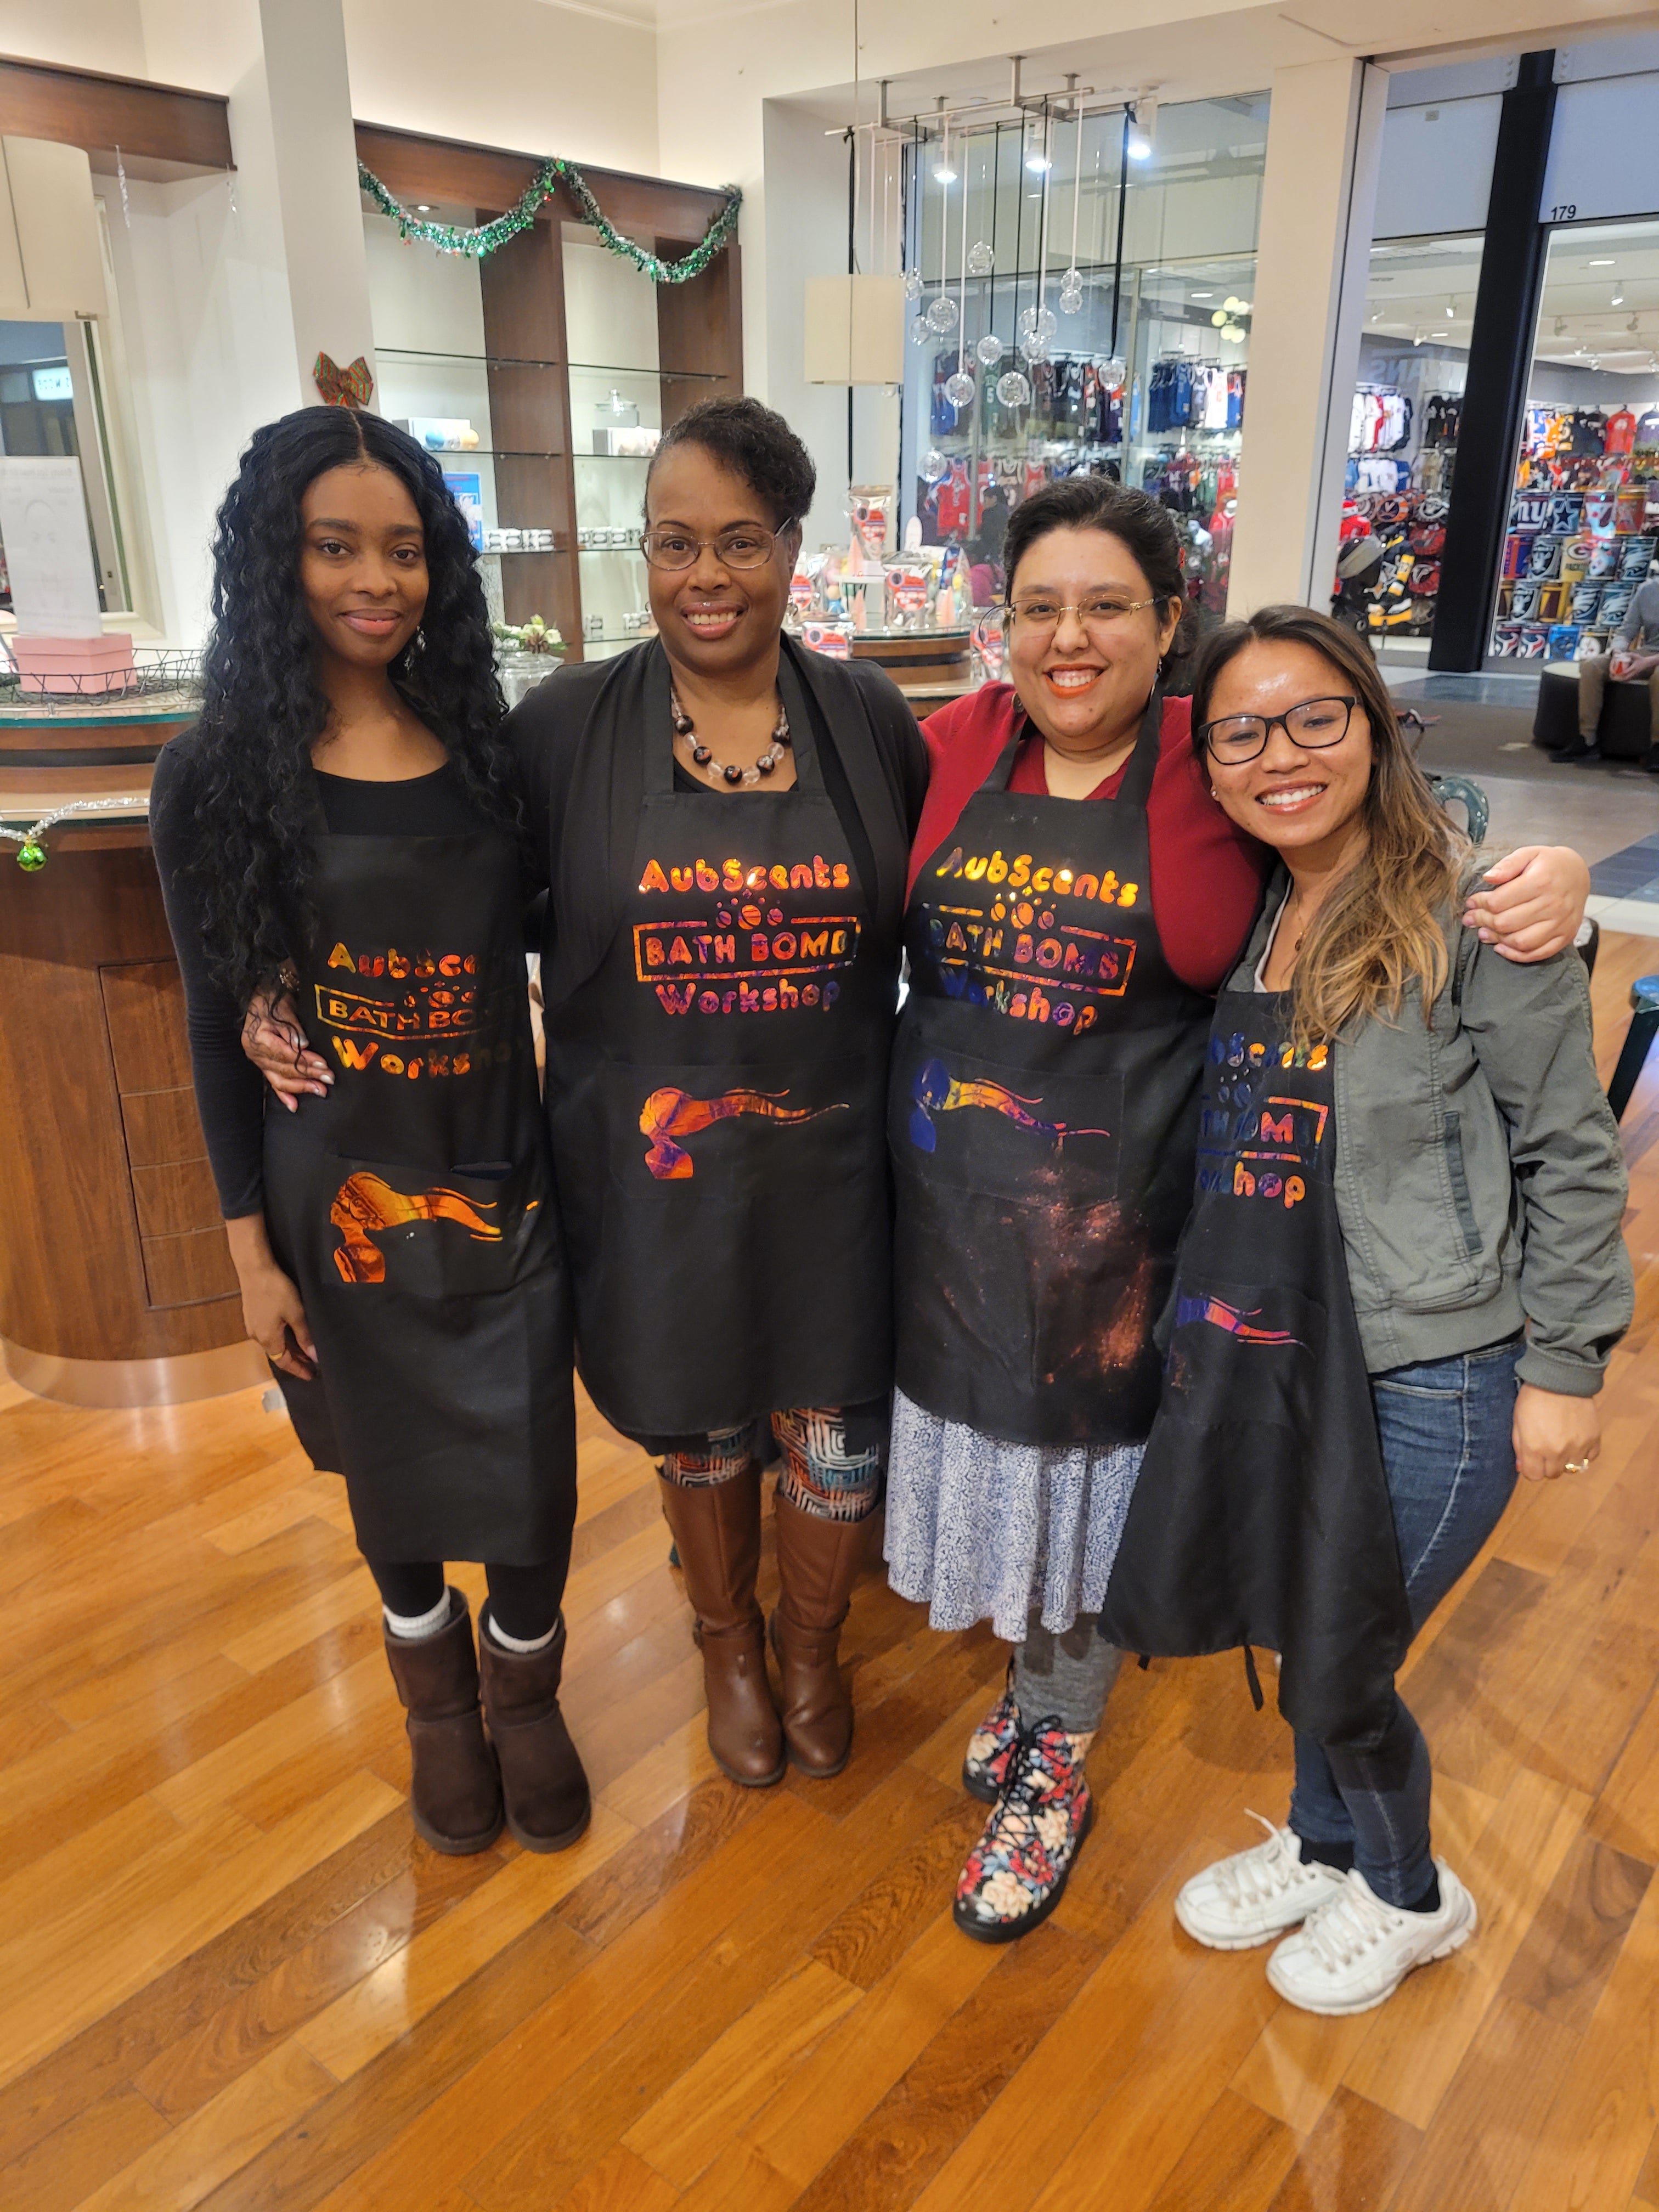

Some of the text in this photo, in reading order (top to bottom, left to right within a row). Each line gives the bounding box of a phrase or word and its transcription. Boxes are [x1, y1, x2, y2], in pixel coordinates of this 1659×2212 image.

[1551, 205, 1576, 220] 179
[638, 855, 850, 893] AubScents
[936, 847, 1139, 907] AubScents
[645, 935, 735, 966] BATH
[655, 978, 840, 1014] Workshop
[329, 1000, 476, 1030] BATH BO
